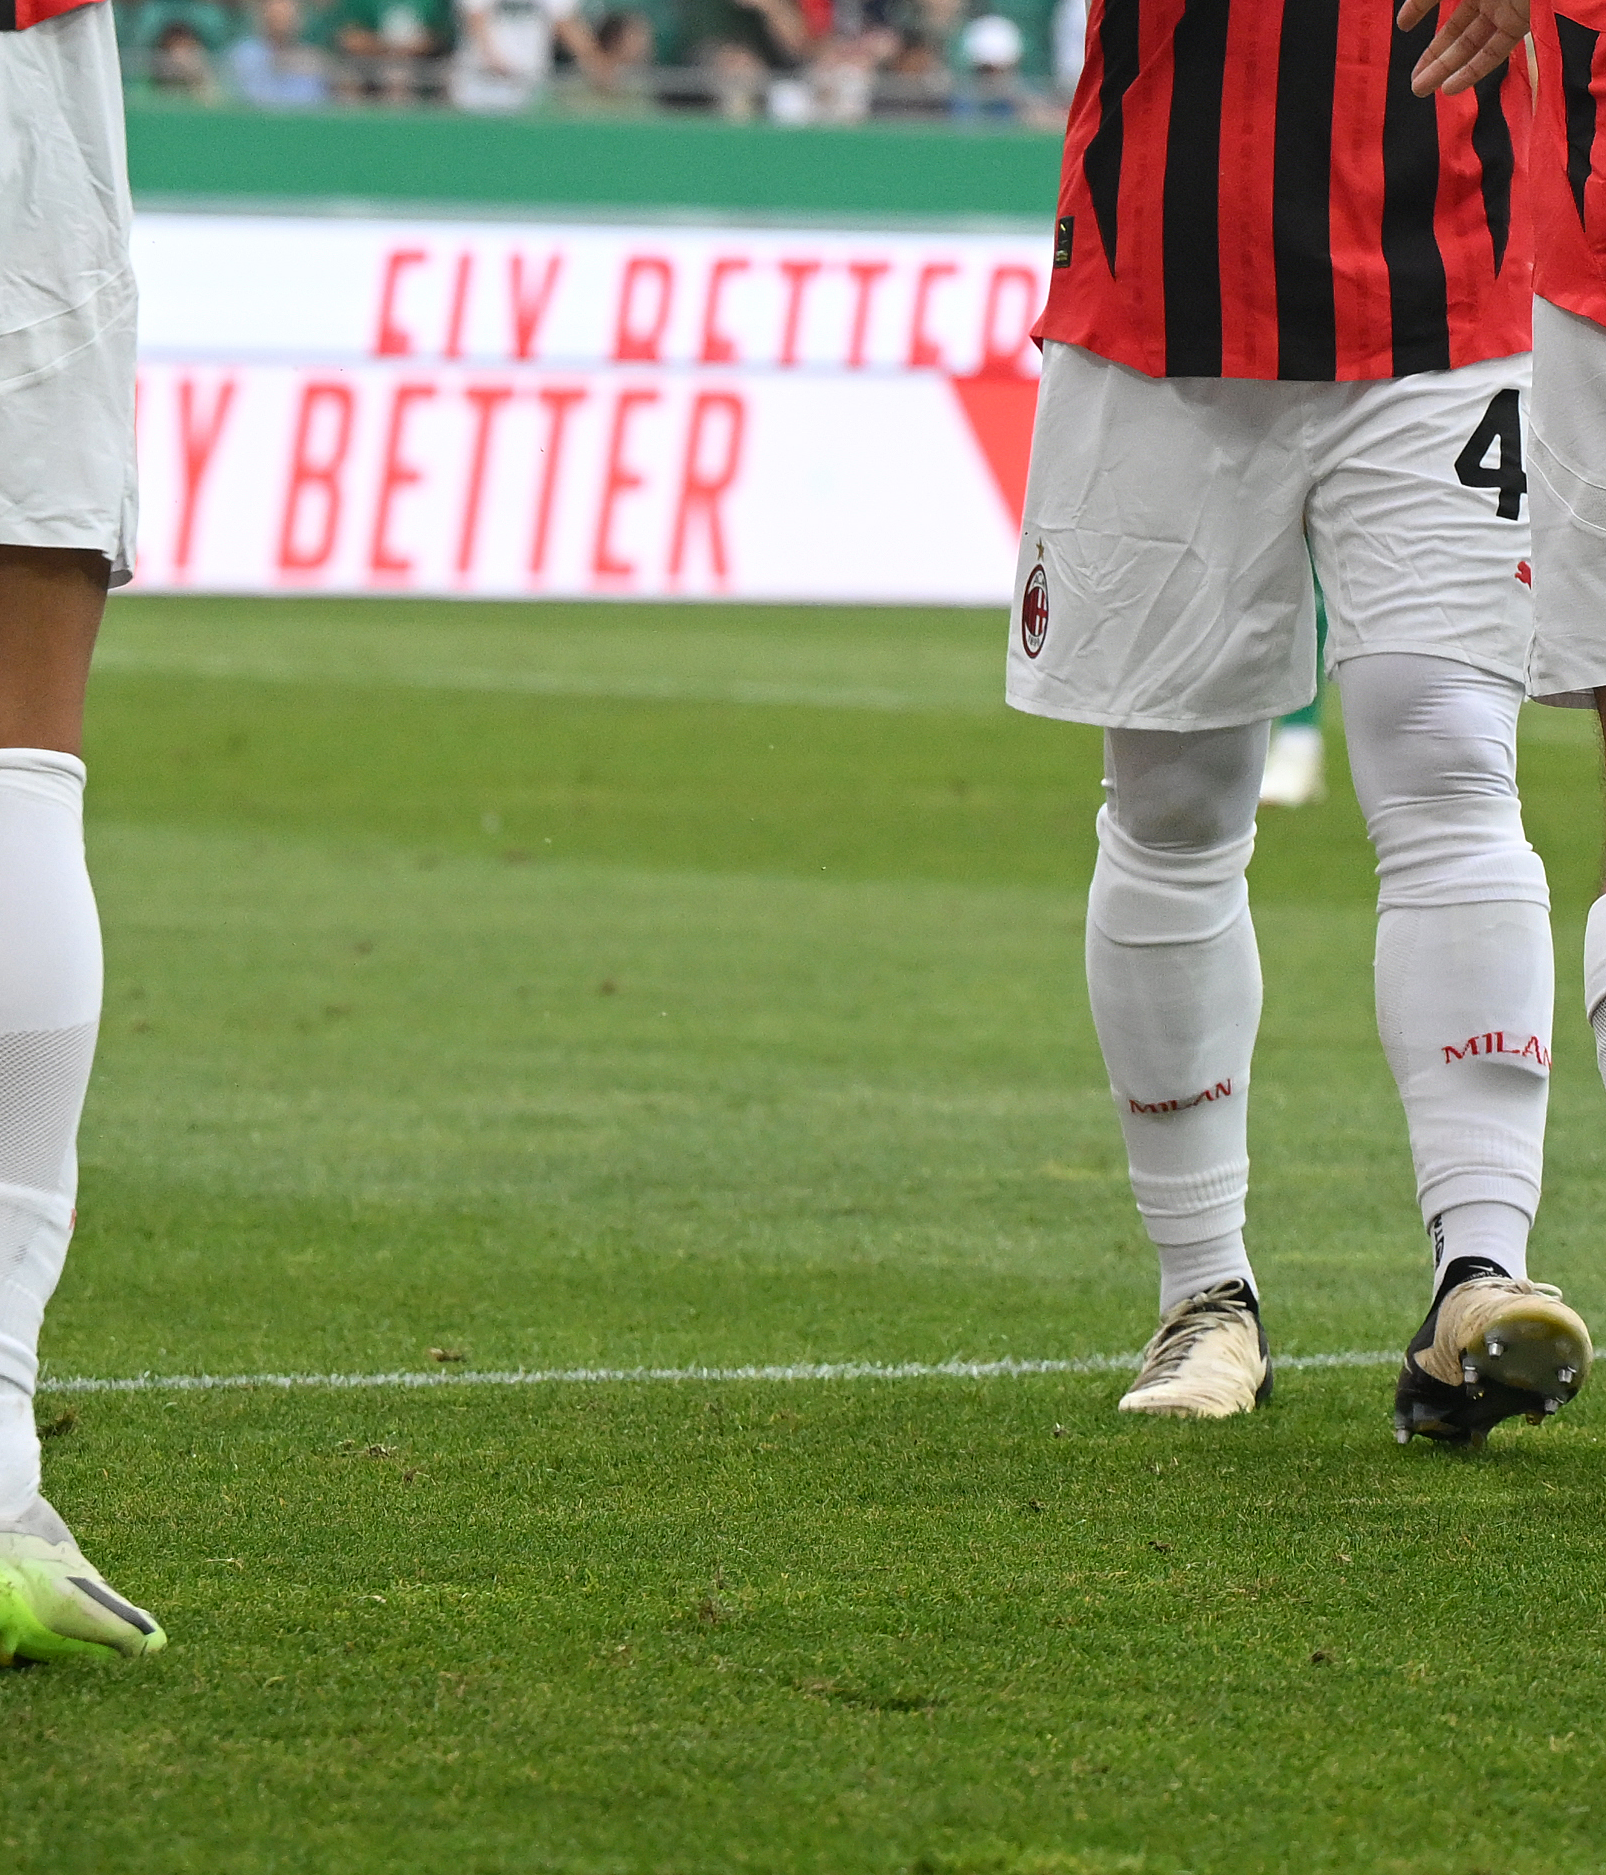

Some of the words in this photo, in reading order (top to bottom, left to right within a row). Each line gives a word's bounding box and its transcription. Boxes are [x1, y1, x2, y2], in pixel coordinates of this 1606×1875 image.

[276, 380, 752, 584] BETTER
[1454, 388, 1528, 521] 4
[1128, 1078, 1232, 1116] MILAN
